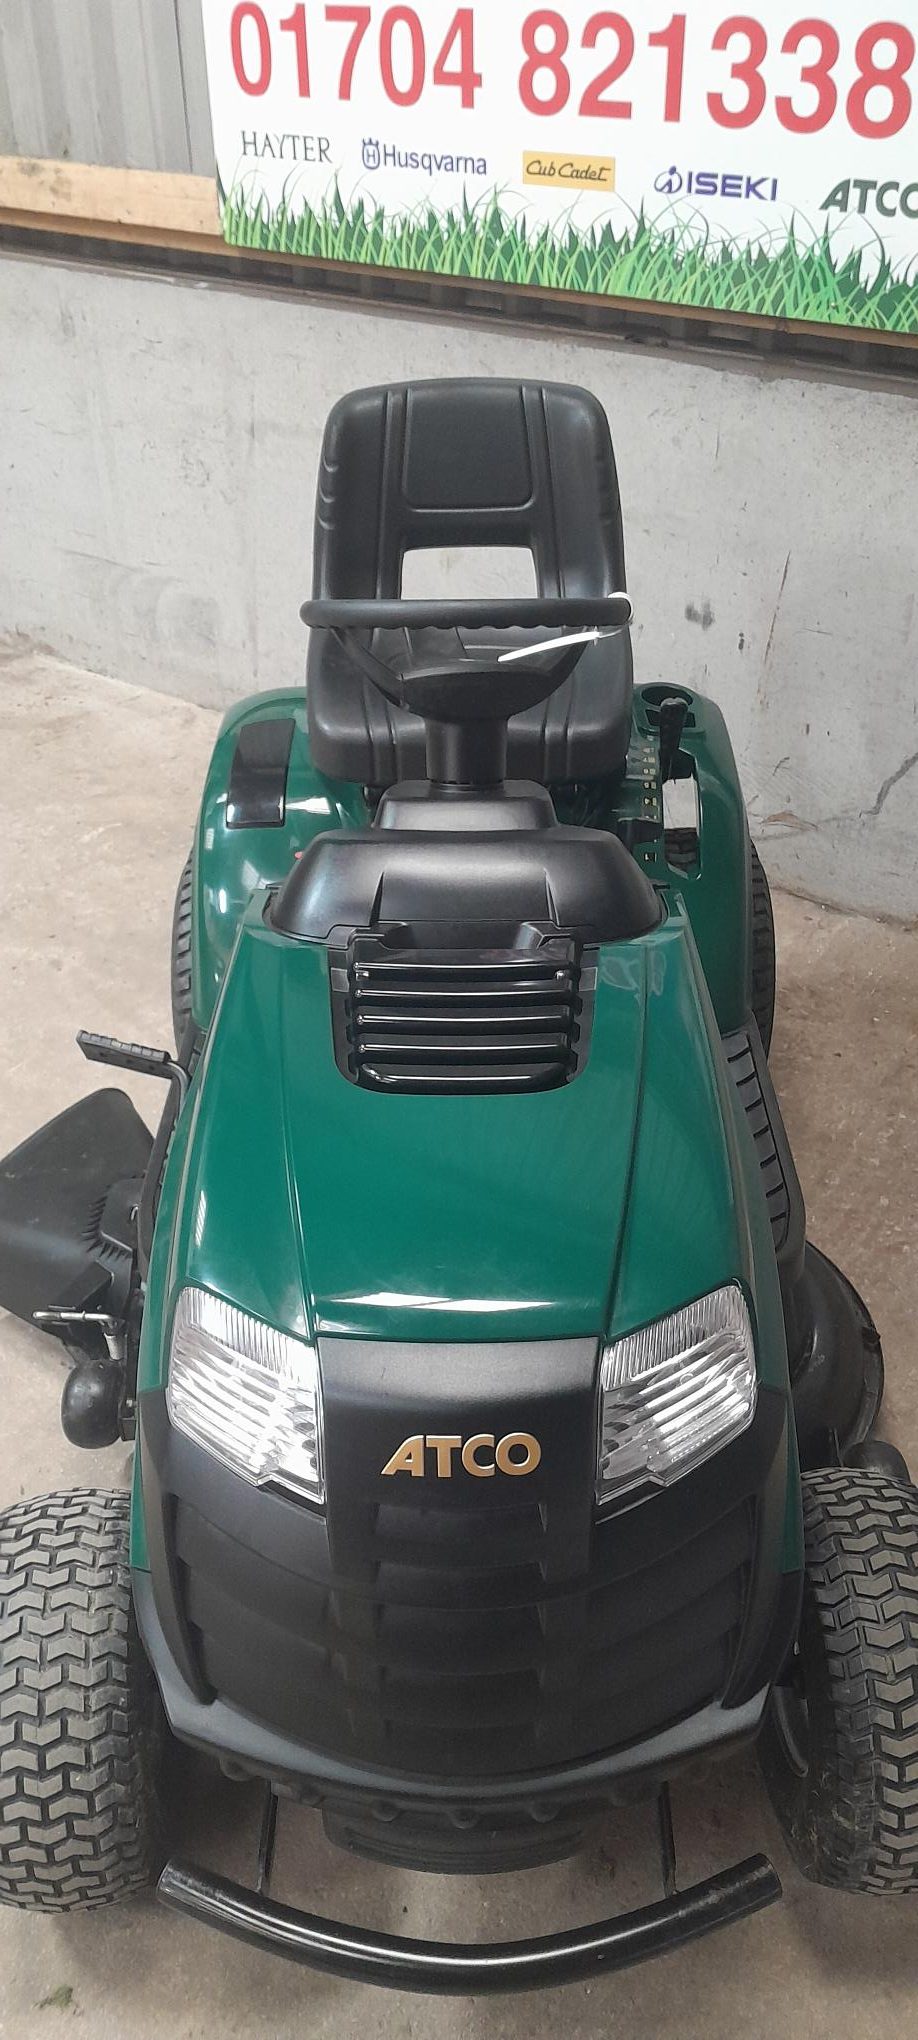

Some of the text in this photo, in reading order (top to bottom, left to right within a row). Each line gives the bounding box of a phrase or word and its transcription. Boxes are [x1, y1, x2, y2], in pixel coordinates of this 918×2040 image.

[230, 1, 916, 139] 01704 821338
[241, 130, 333, 164] HAYTER
[383, 144, 487, 176] Husqvarna
[526, 159, 612, 182] Cub Cadet
[686, 172, 778, 202] ISEKI
[380, 1432, 542, 1478] ATCO
